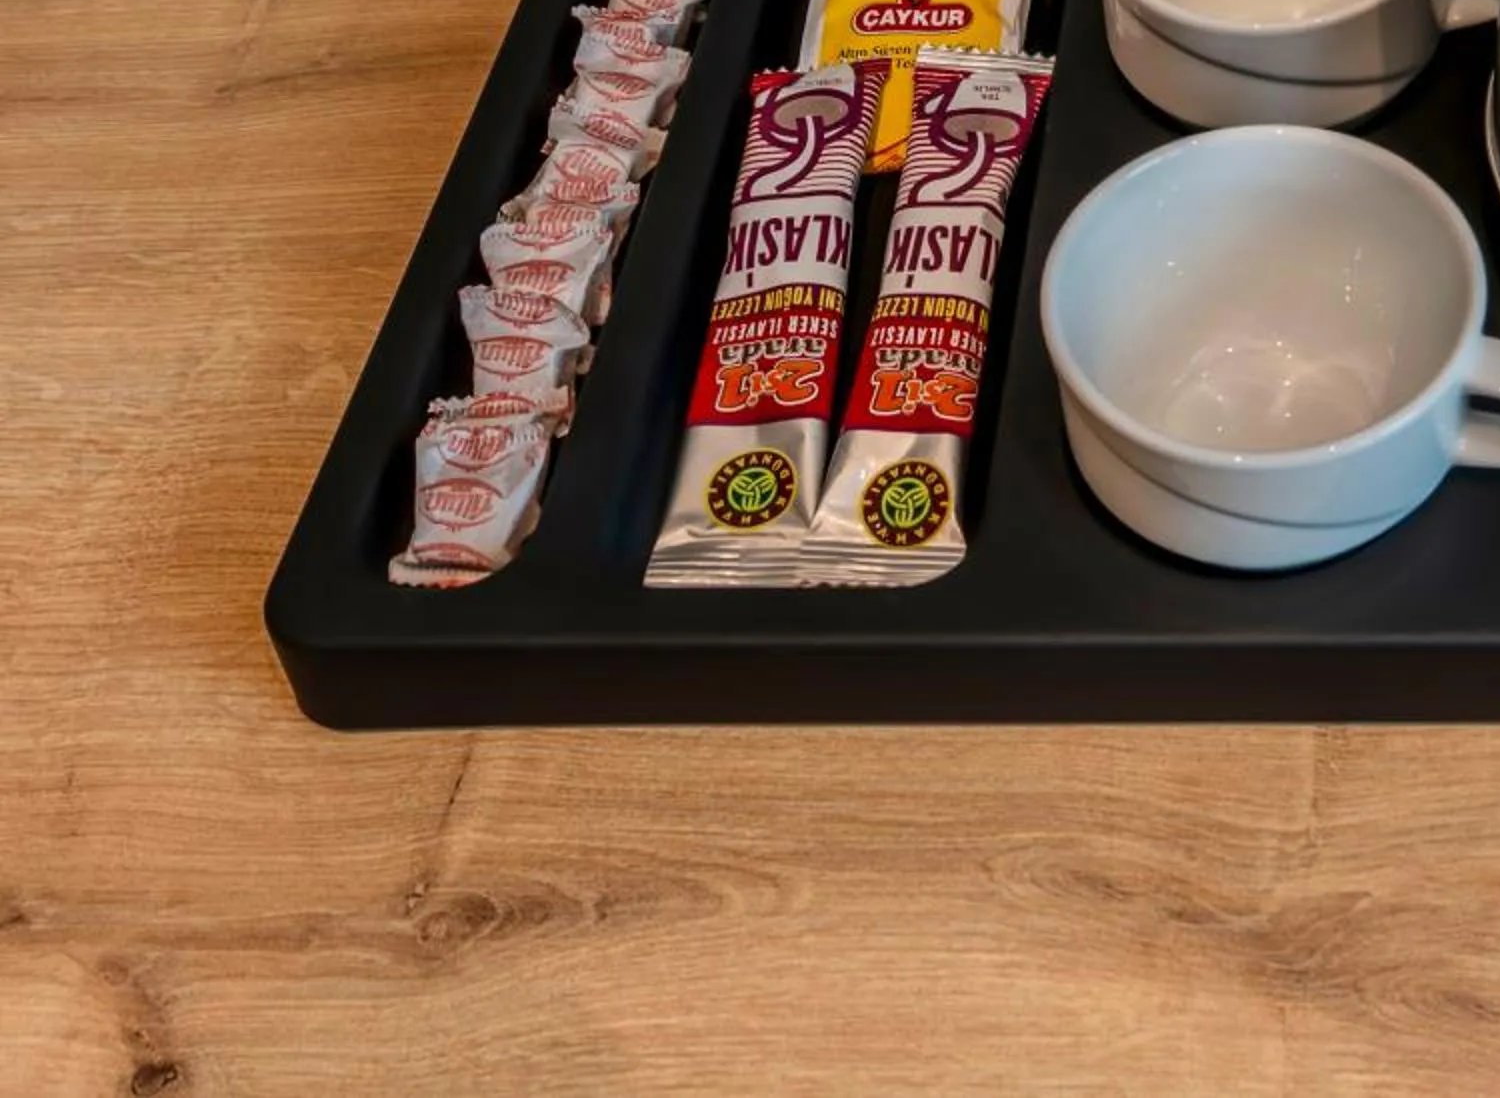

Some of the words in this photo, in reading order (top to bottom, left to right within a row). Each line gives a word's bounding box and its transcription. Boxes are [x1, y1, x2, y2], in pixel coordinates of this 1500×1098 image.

[862, 8, 965, 29] ÇAYKUR
[724, 213, 852, 288] KLASİK
[763, 285, 813, 312] YOĞUN
[923, 296, 975, 323] YOĞUN
[719, 336, 827, 368] arada
[876, 346, 984, 379] arada
[717, 453, 791, 484] DÜNYASI
[870, 465, 945, 496] DÜNYASI
[712, 497, 787, 525] KAHVE
[867, 510, 942, 545] KAHVE
